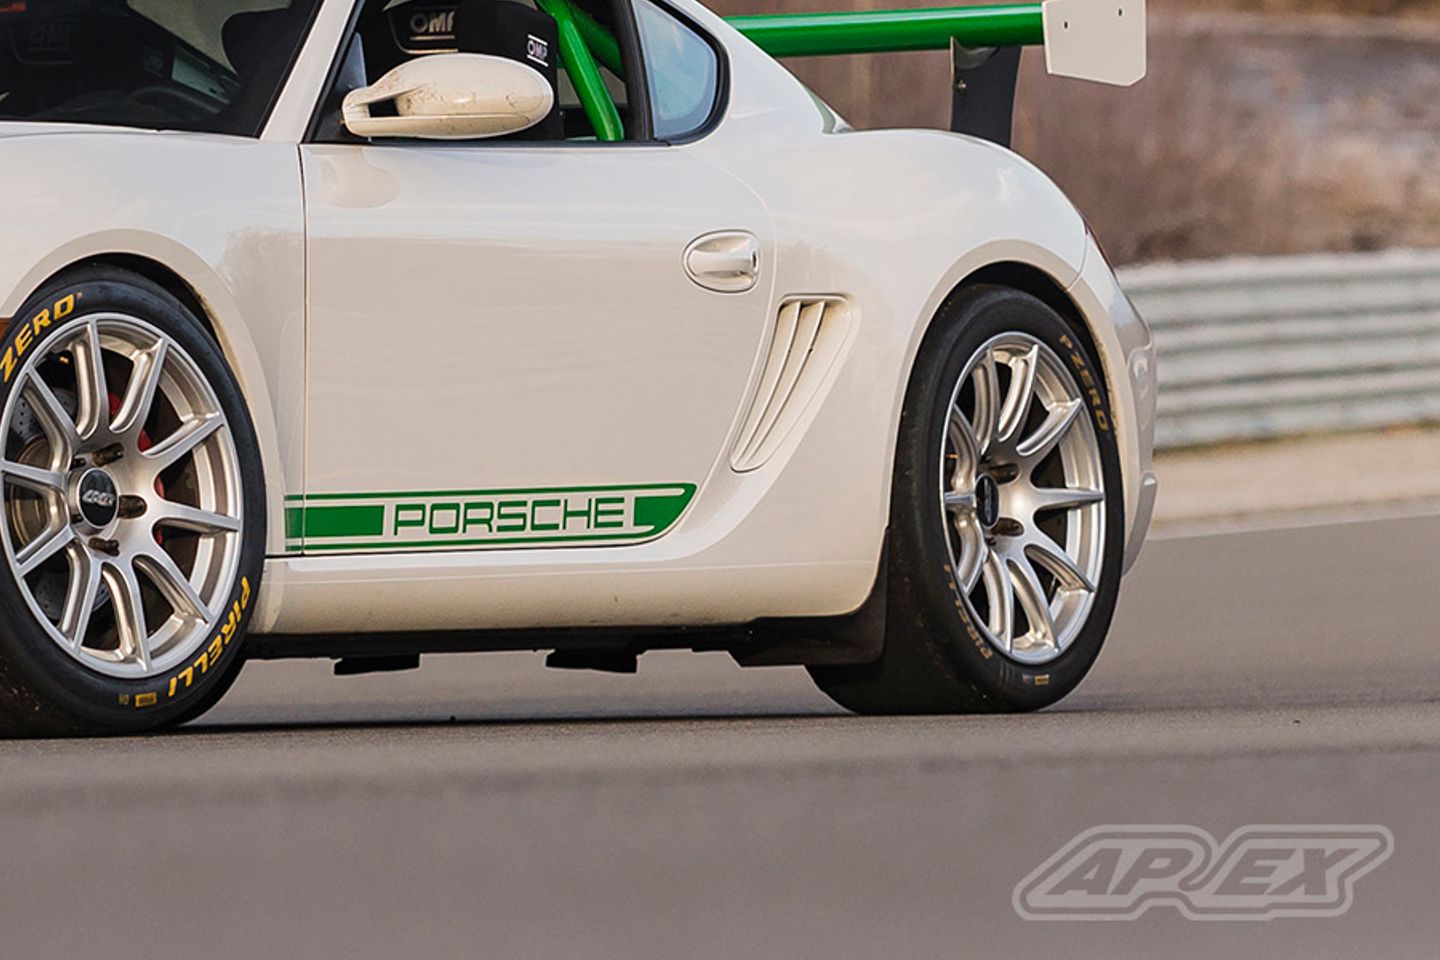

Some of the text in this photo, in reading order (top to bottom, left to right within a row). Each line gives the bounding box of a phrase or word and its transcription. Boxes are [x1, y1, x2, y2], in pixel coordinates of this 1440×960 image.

[0, 294, 75, 382] ZERO
[393, 497, 625, 536] PORSCHE
[168, 576, 251, 697] PIRELLI
